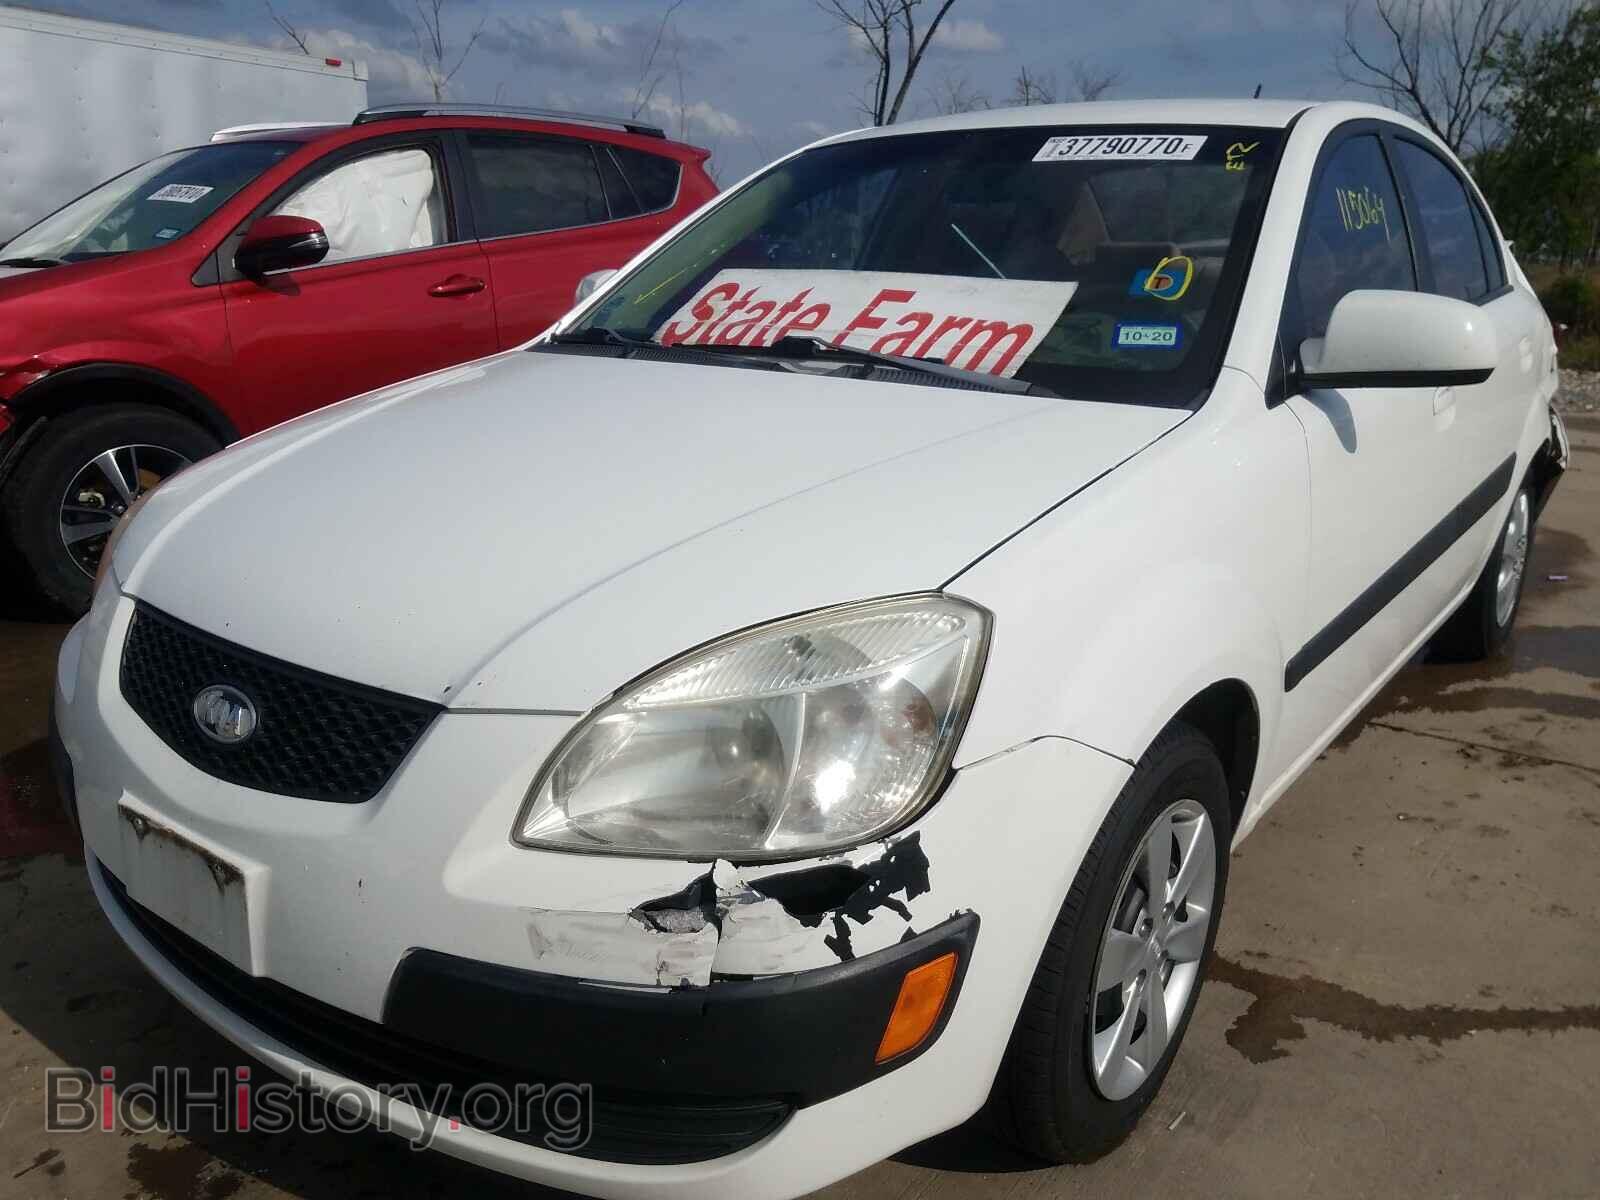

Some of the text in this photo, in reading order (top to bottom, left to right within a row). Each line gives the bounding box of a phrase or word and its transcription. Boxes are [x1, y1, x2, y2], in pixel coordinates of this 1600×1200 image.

[1058, 137, 1183, 155] 37790770
[661, 282, 1034, 376] State Farm
[1121, 331, 1173, 342] 10-20
